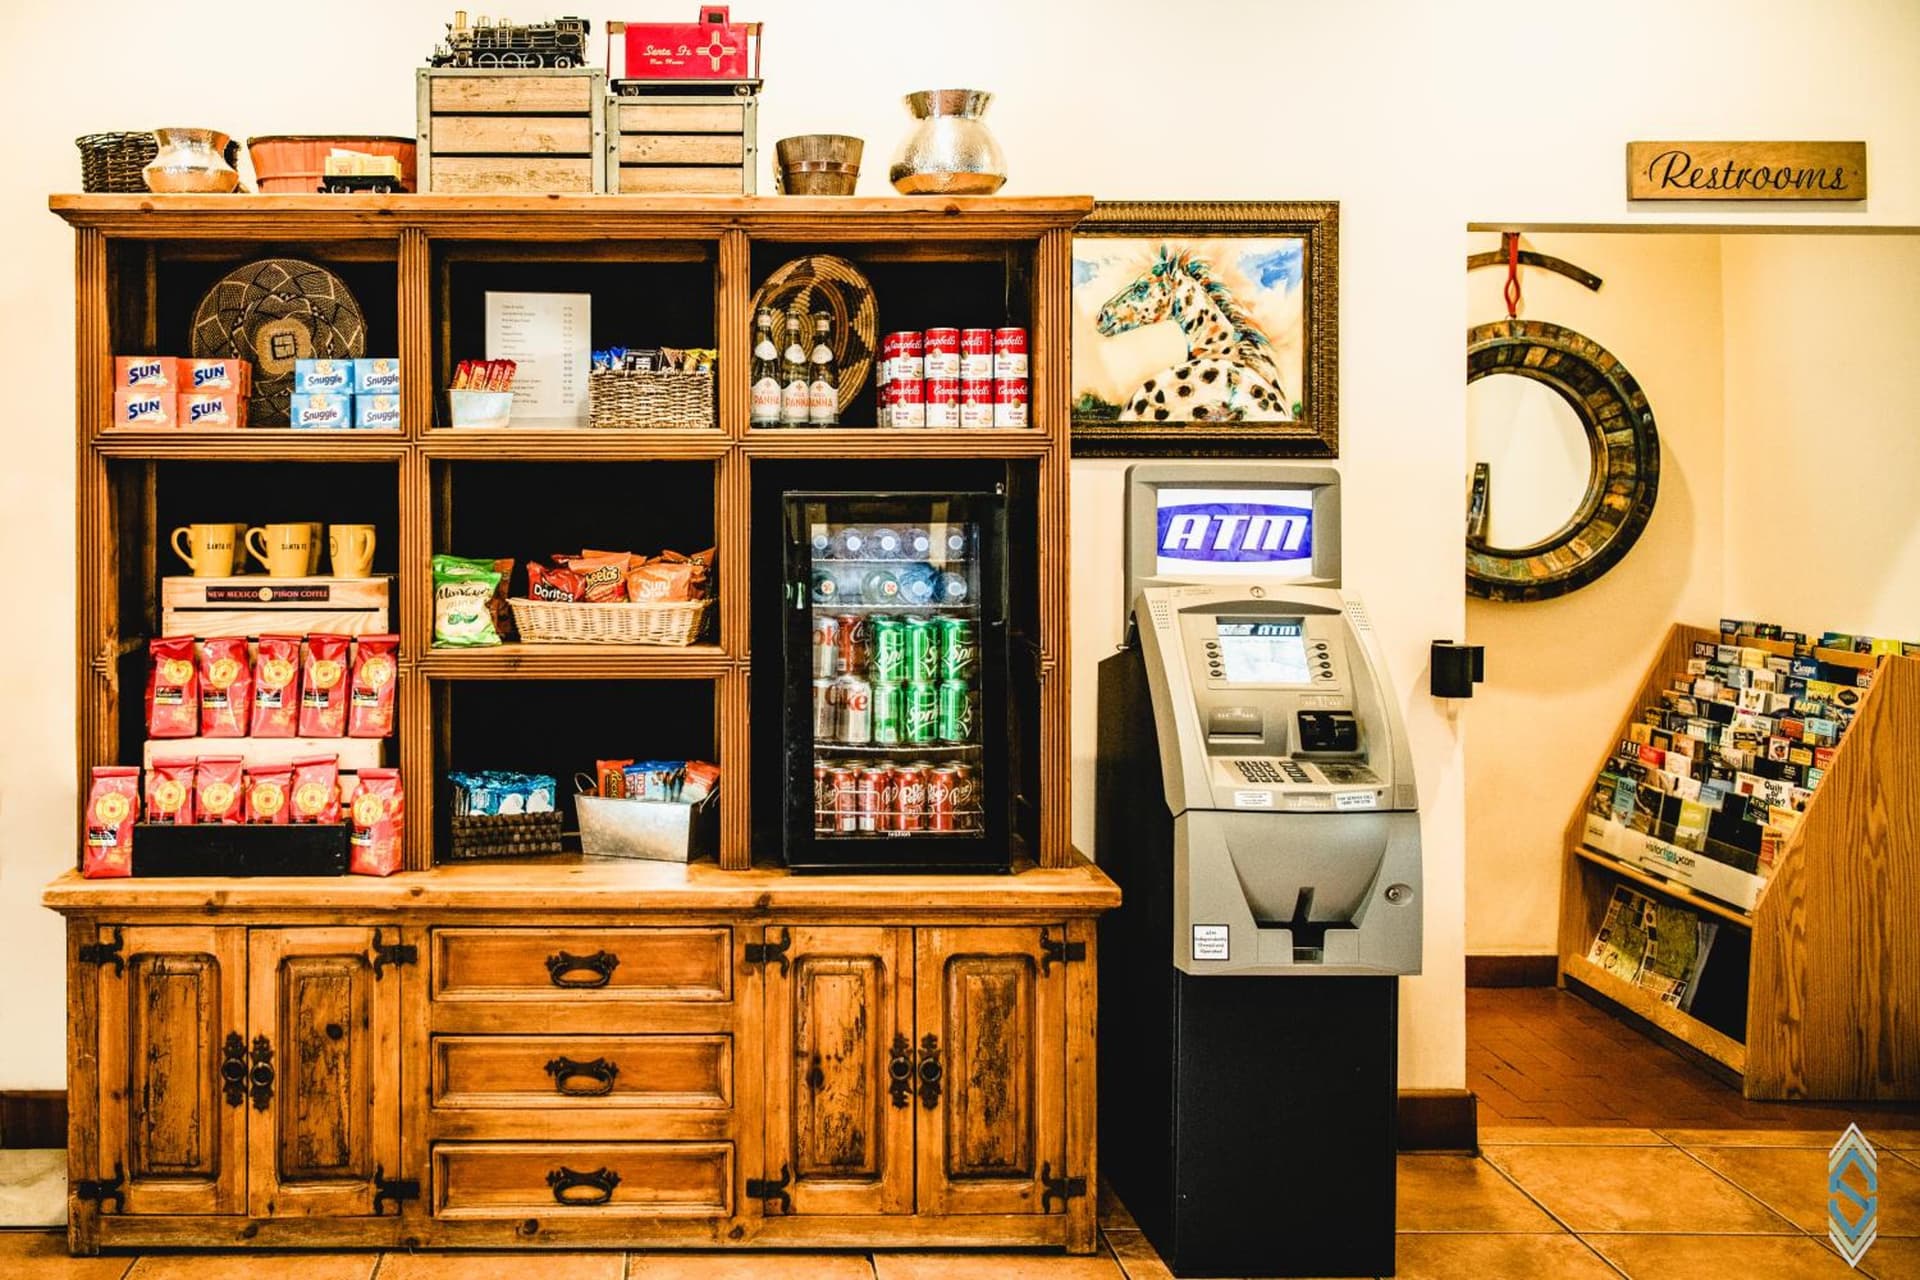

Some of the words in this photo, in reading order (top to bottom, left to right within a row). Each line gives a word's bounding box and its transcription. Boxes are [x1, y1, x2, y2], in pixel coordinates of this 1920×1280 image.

[1648, 150, 1849, 191] Restrooms
[129, 364, 161, 384] SUN
[195, 366, 225, 386] SUN
[308, 375, 343, 387] Snuggle
[128, 400, 160, 420] SUN
[191, 401, 222, 421] SUN
[303, 411, 338, 422] Snuggle
[1161, 514, 1309, 551] ATM
[533, 583, 574, 603] Doritos
[1257, 624, 1297, 635] ATM
